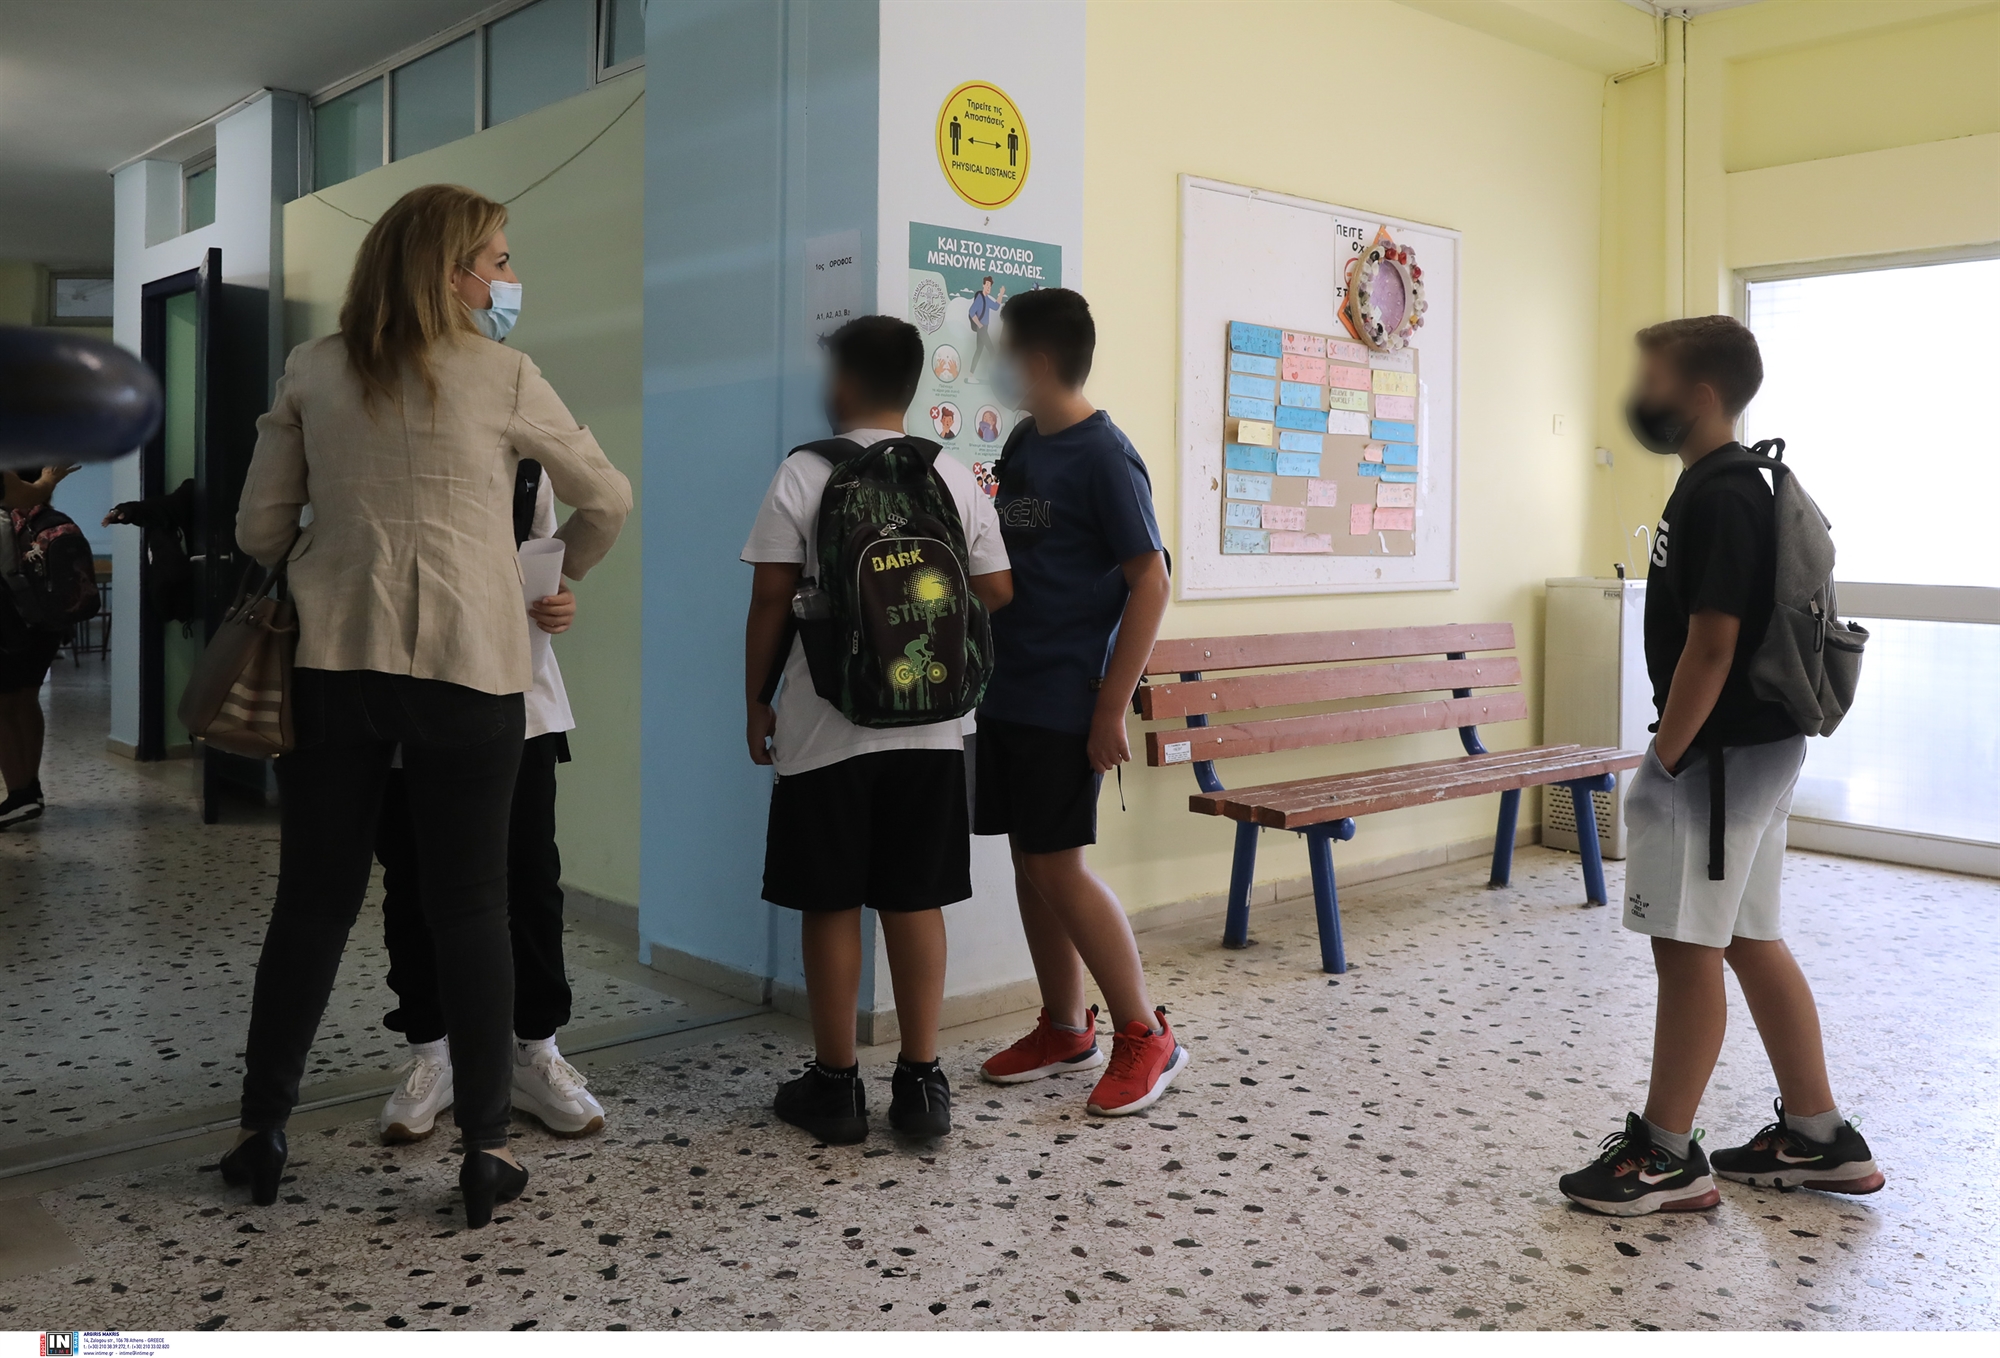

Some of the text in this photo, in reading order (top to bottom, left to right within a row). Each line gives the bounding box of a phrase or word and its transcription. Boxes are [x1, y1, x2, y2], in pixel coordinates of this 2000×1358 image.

[967, 98, 1002, 116] Τηρείτε τις
[964, 111, 1005, 129] Αποστάσεις
[952, 160, 1016, 180] PHYSICAL DISTANCE
[938, 236, 1034, 263] ΚΑΙ ΣΤΟ ΣΧΟΛΕΙΟ
[829, 256, 852, 268] ΟΡΟΦΟΣ
[927, 251, 1046, 280] ΜΕΝΟΥΜΕ ΑΣΦΑΛΕΙΣ.
[995, 497, 1051, 528] GEN
[871, 549, 925, 573] DARK
[886, 595, 957, 625] STREET
